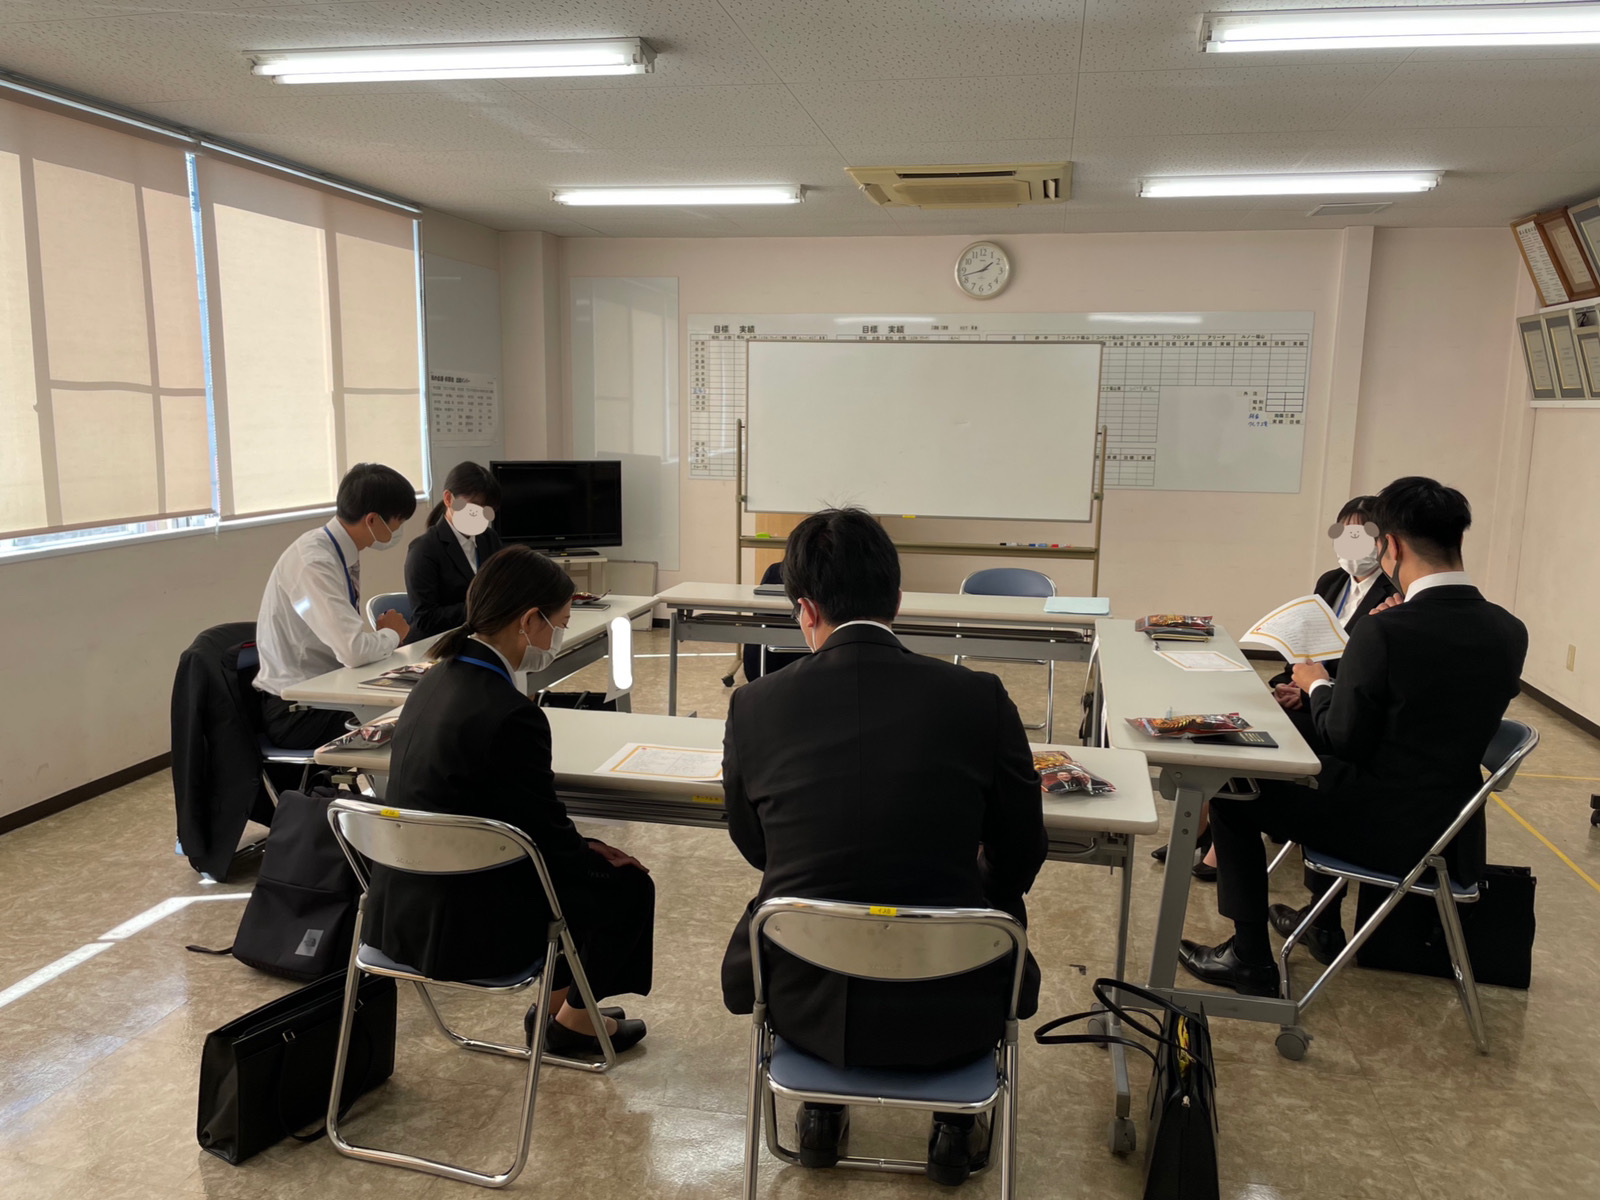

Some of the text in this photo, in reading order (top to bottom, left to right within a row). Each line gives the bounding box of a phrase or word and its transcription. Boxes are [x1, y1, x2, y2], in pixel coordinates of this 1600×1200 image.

[980, 248, 988, 256] 12
[998, 267, 1004, 275] 3
[714, 325, 755, 334] 目標 実績
[862, 326, 904, 334] 目標 実績
